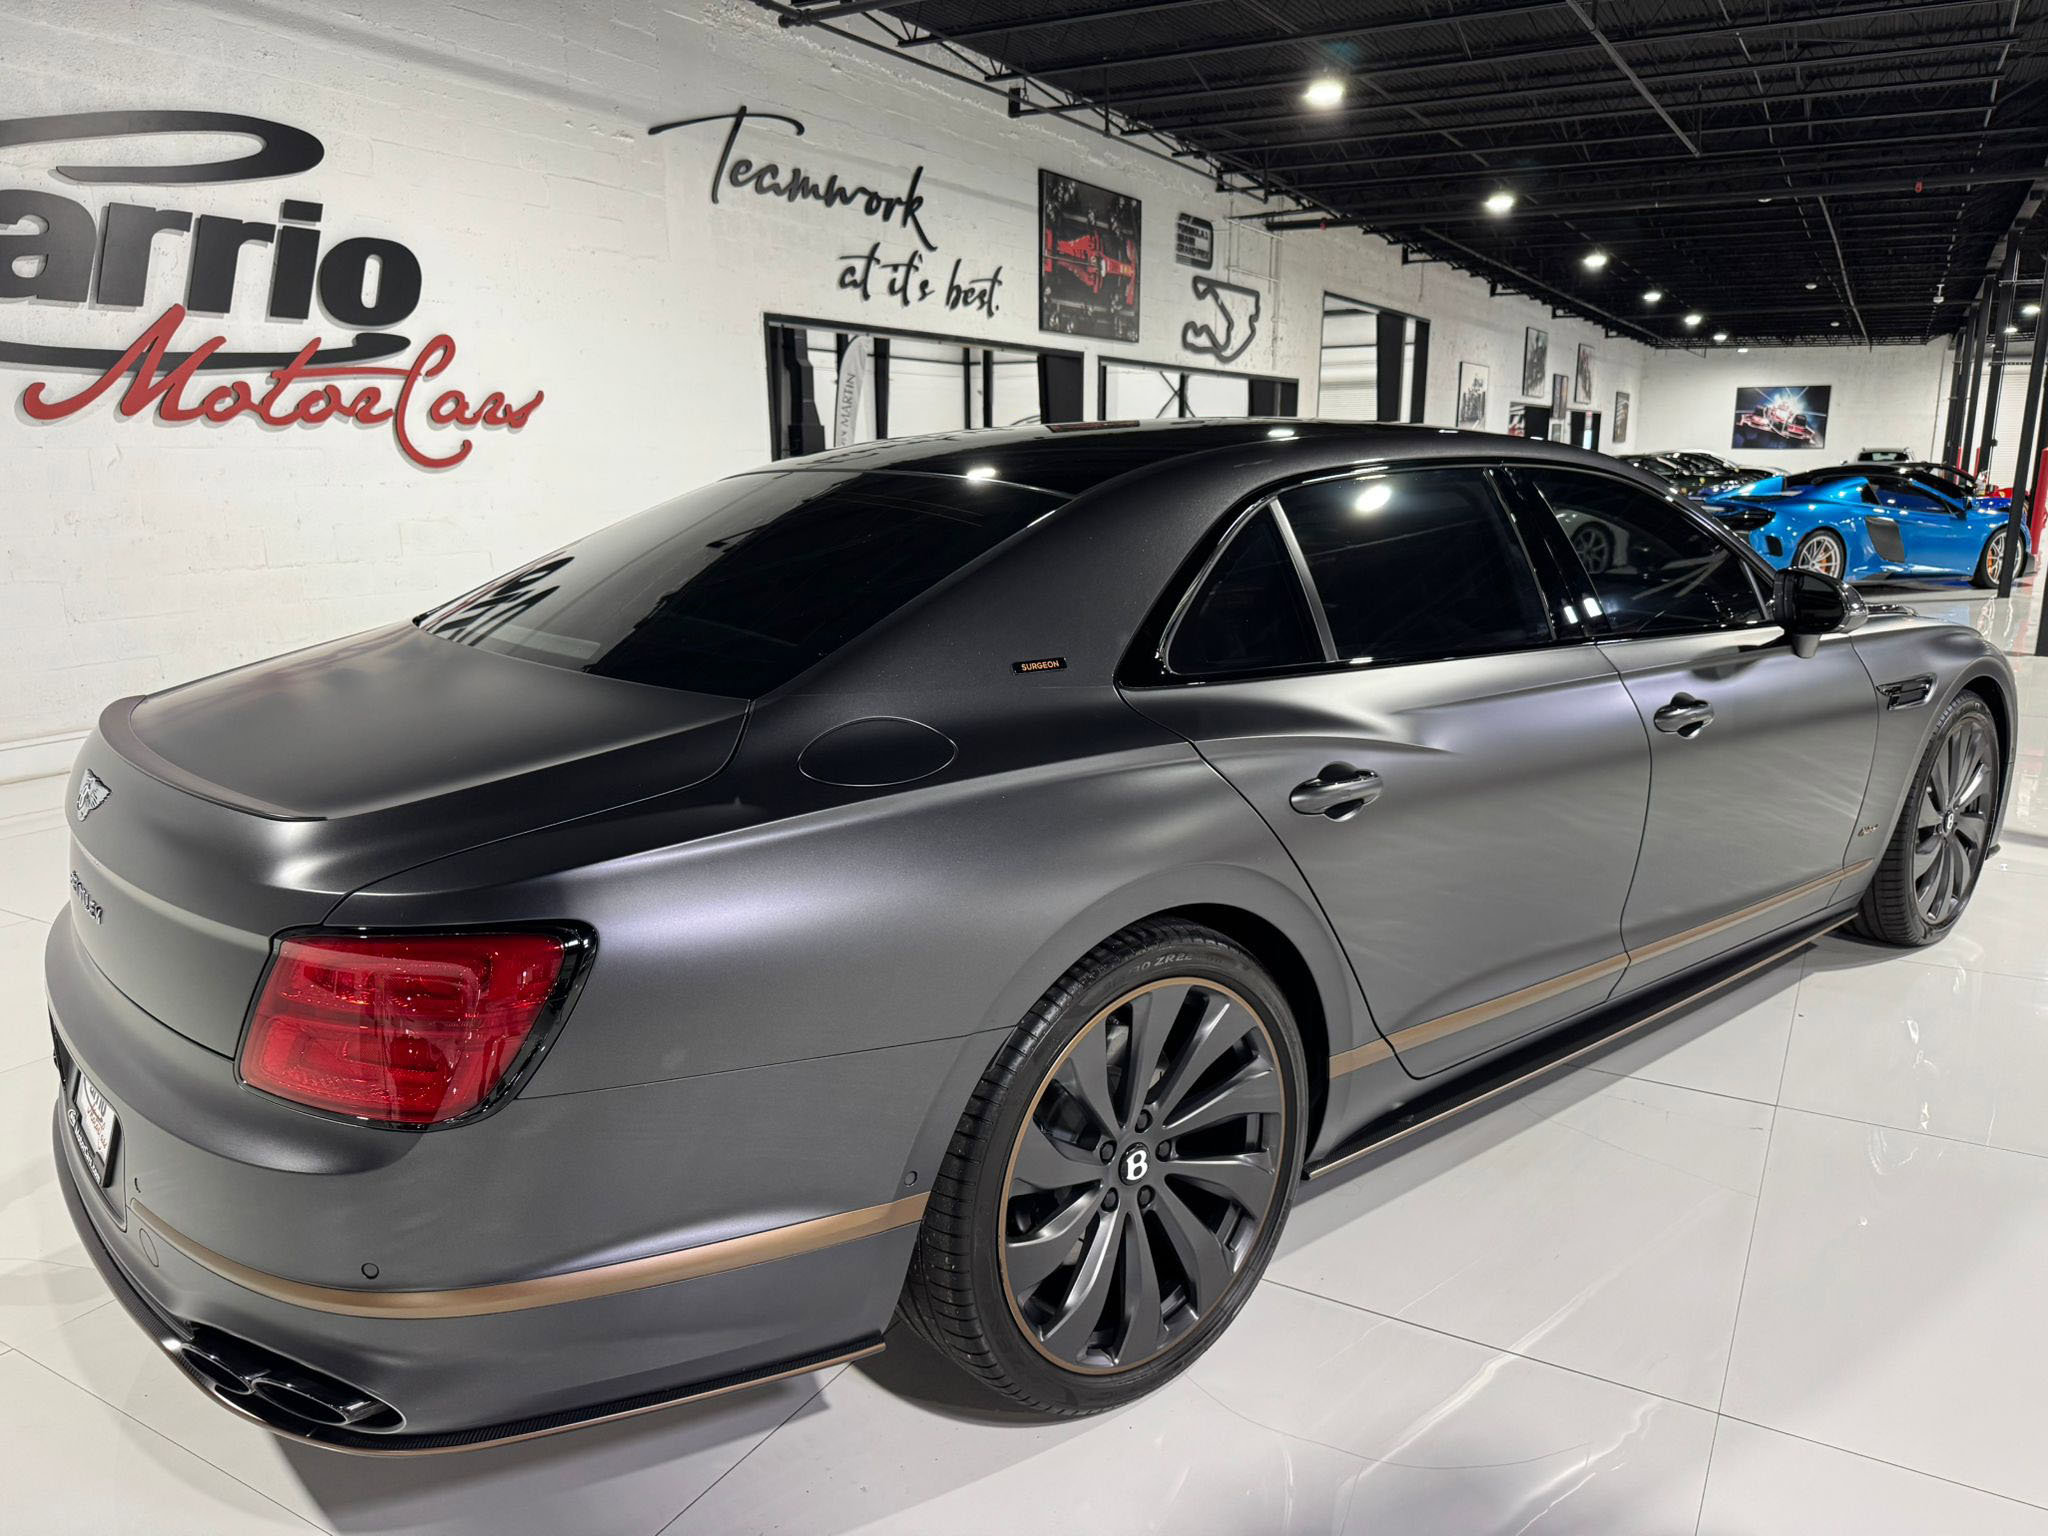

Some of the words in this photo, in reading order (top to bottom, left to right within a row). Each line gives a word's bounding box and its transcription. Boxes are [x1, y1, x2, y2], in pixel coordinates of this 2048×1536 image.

[648, 105, 937, 251] Teamwork
[838, 242, 881, 301] at
[880, 250, 934, 307] it's
[840, 373, 856, 428] MARTIN
[1021, 660, 1060, 671] SURGEON
[1126, 1149, 1149, 1181] B
